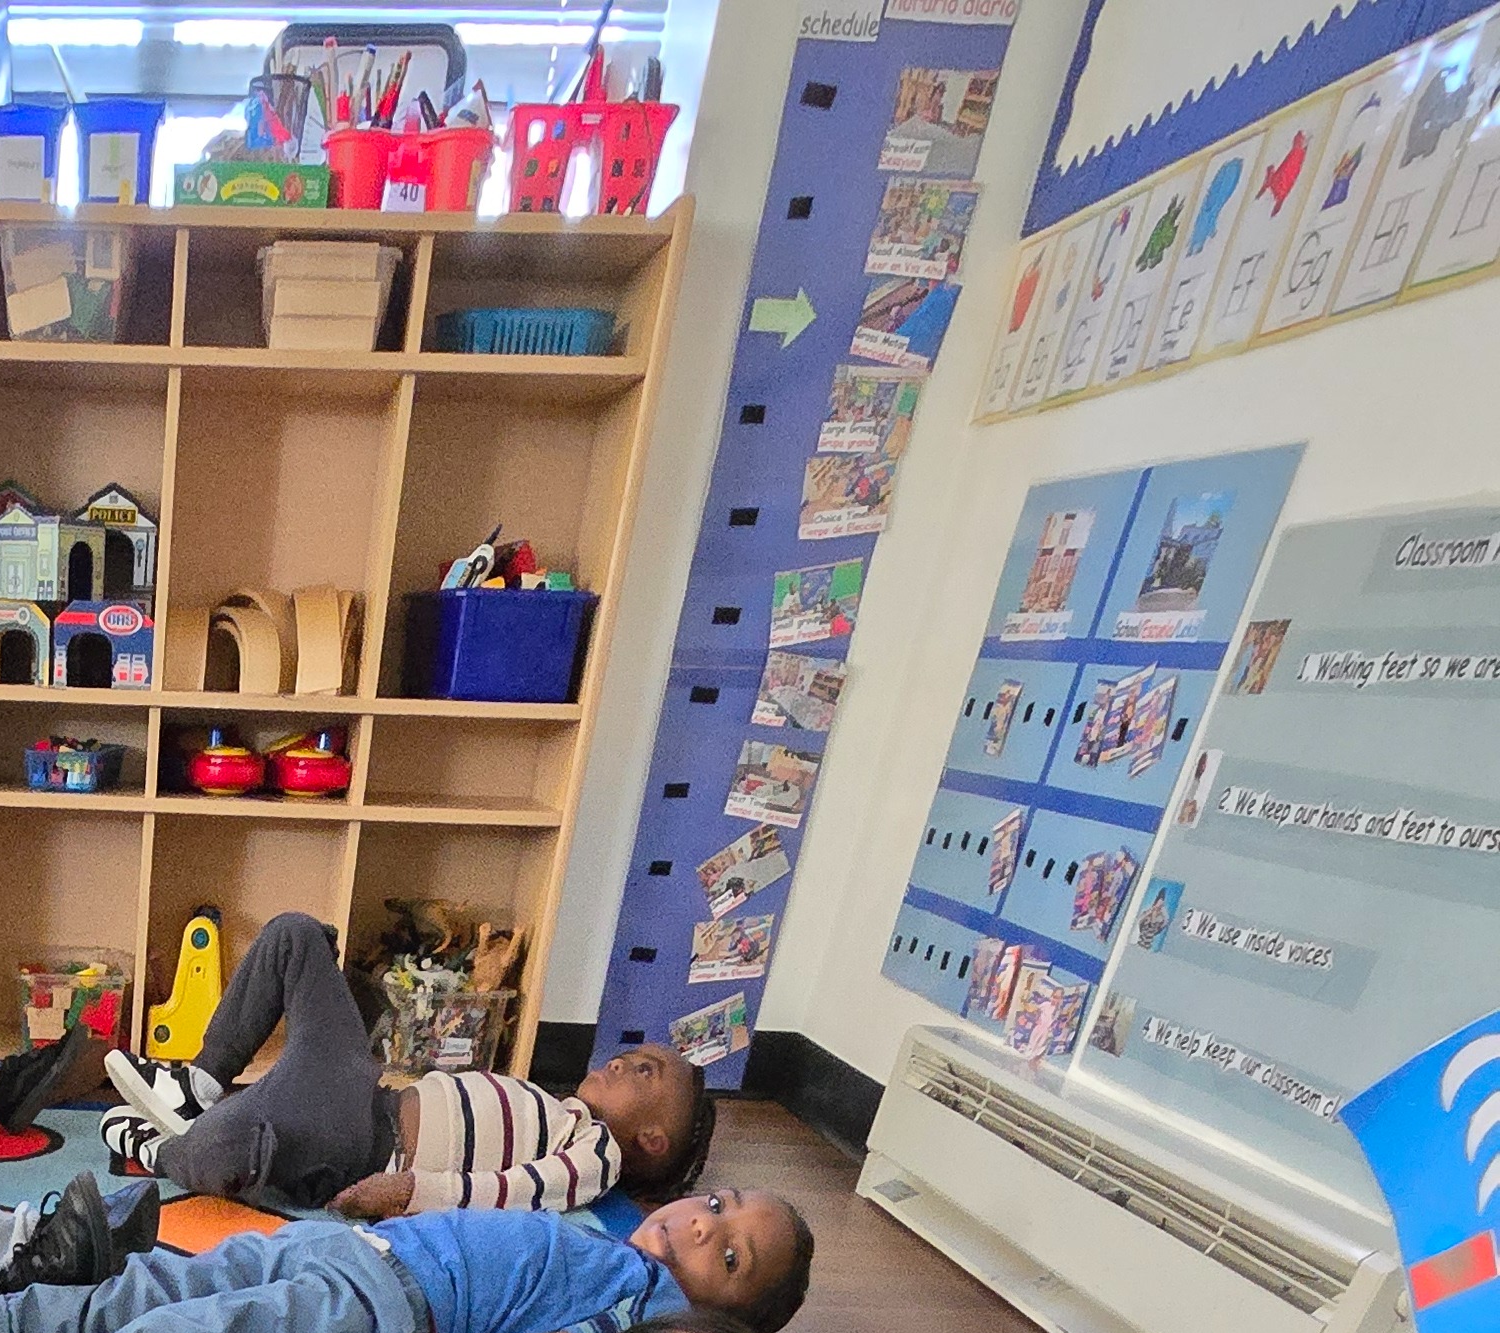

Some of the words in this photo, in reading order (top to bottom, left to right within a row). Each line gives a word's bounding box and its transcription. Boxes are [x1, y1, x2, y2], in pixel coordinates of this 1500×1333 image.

[801, 10, 879, 38] schedule
[400, 184, 419, 202] 40
[91, 508, 137, 523] POLICE
[1395, 532, 1491, 567] Classroom
[106, 613, 134, 626] GAS
[1315, 652, 1375, 689] Walking
[1377, 650, 1418, 681] feet
[1418, 657, 1442, 679] so
[1444, 657, 1472, 679] we
[1218, 787, 1230, 812] 2.
[1234, 789, 1255, 815] We
[1258, 790, 1292, 827] keep
[1293, 807, 1318, 827] our
[1318, 802, 1363, 832] hands
[1365, 810, 1397, 836] and
[1398, 810, 1436, 843] feet
[1436, 816, 1456, 845] to
[1196, 911, 1217, 939] We
[1218, 925, 1241, 946] use
[1243, 927, 1286, 958] inside
[1287, 939, 1333, 969] voices.
[1153, 1019, 1172, 1046] We
[1173, 1027, 1201, 1060] help
[1202, 1031, 1236, 1071] keep
[1261, 1064, 1322, 1112] classroom
